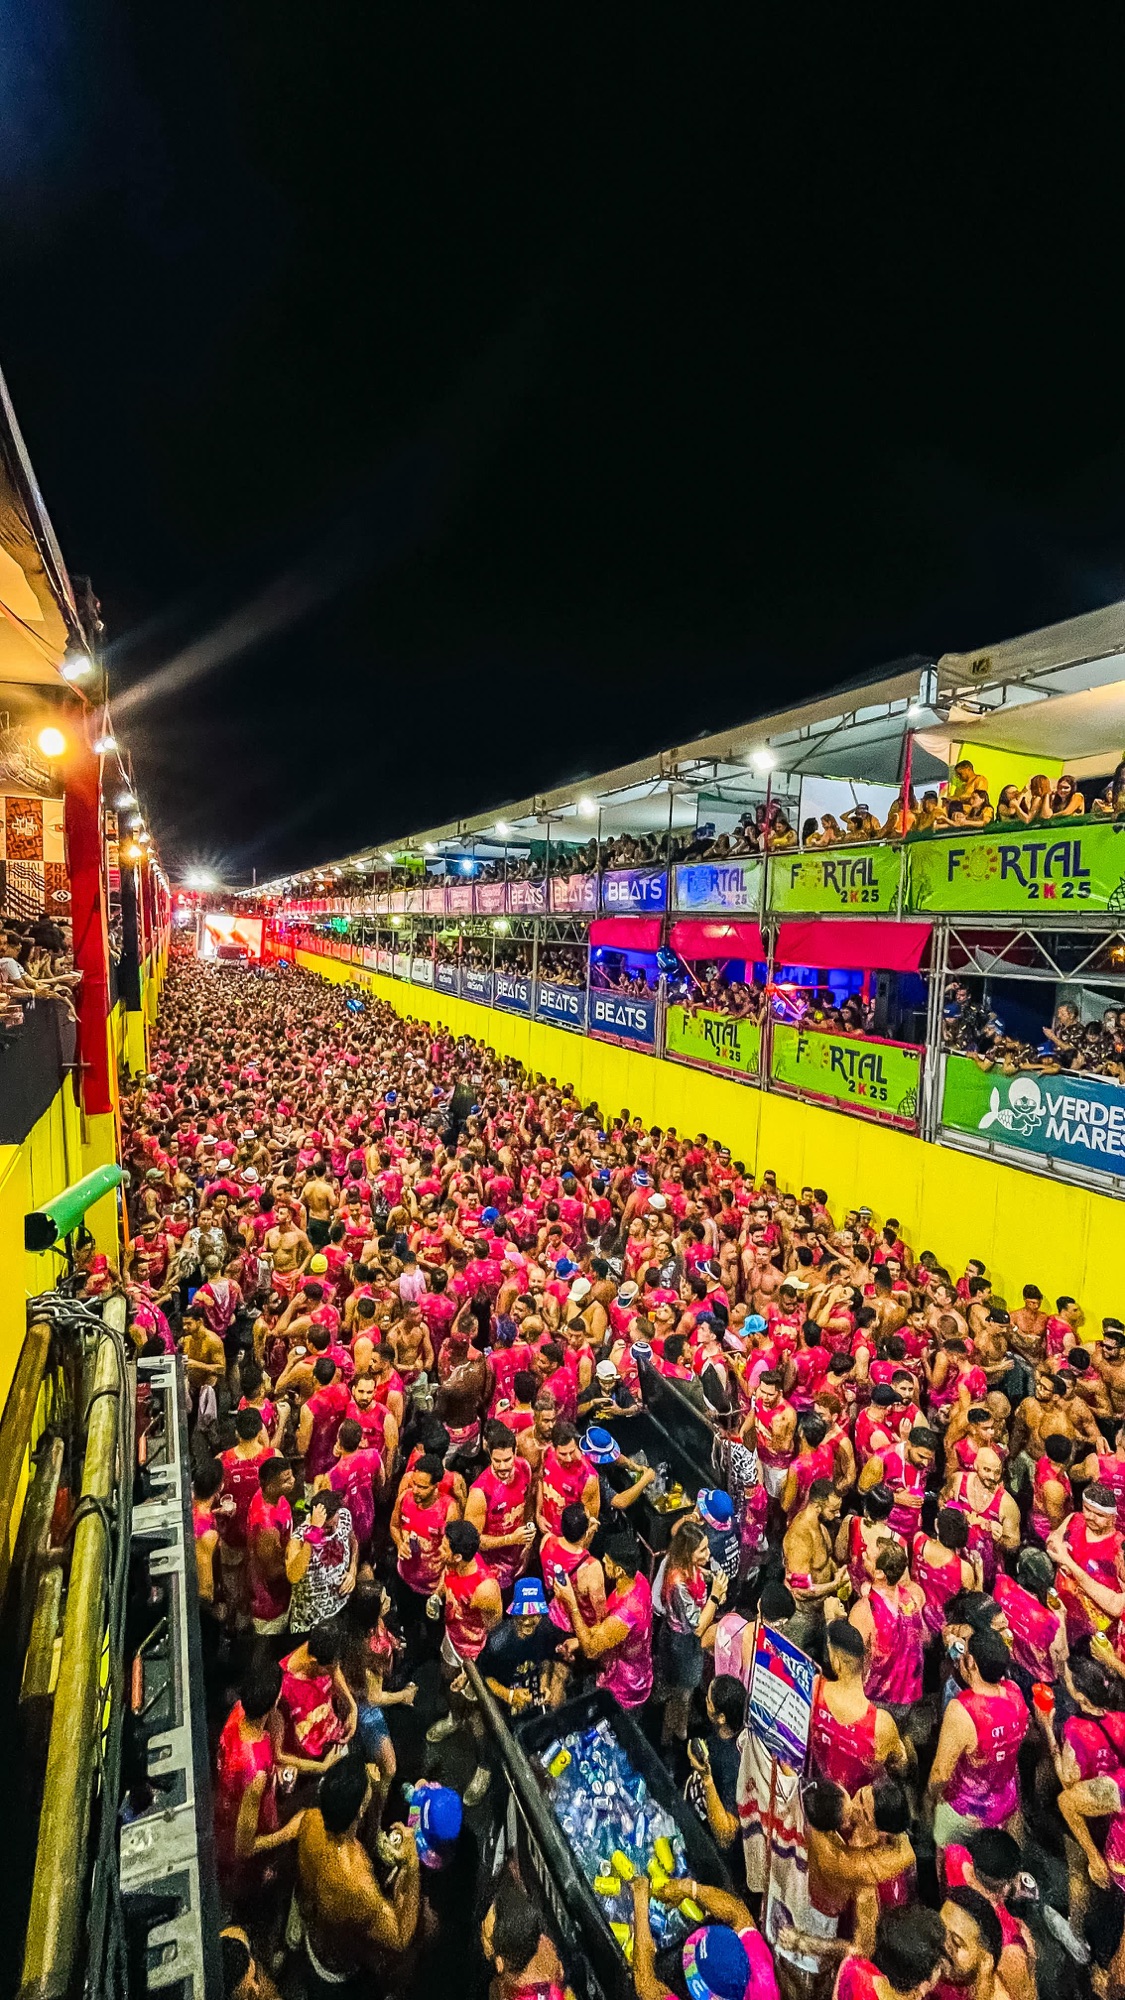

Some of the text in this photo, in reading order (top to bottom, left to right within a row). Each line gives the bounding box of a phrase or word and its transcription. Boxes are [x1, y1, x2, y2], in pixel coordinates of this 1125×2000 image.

[554, 883, 594, 903] BEATS
[608, 878, 662, 901] BEATS
[840, 889, 880, 903] 2K25
[1028, 881, 1091, 899] 2K25
[497, 981, 527, 1001] BEATS
[540, 989, 579, 1014] BEATS
[595, 1001, 647, 1030] BEATS
[715, 1046, 741, 1063] 2K25
[848, 1080, 888, 1101] 2K25
